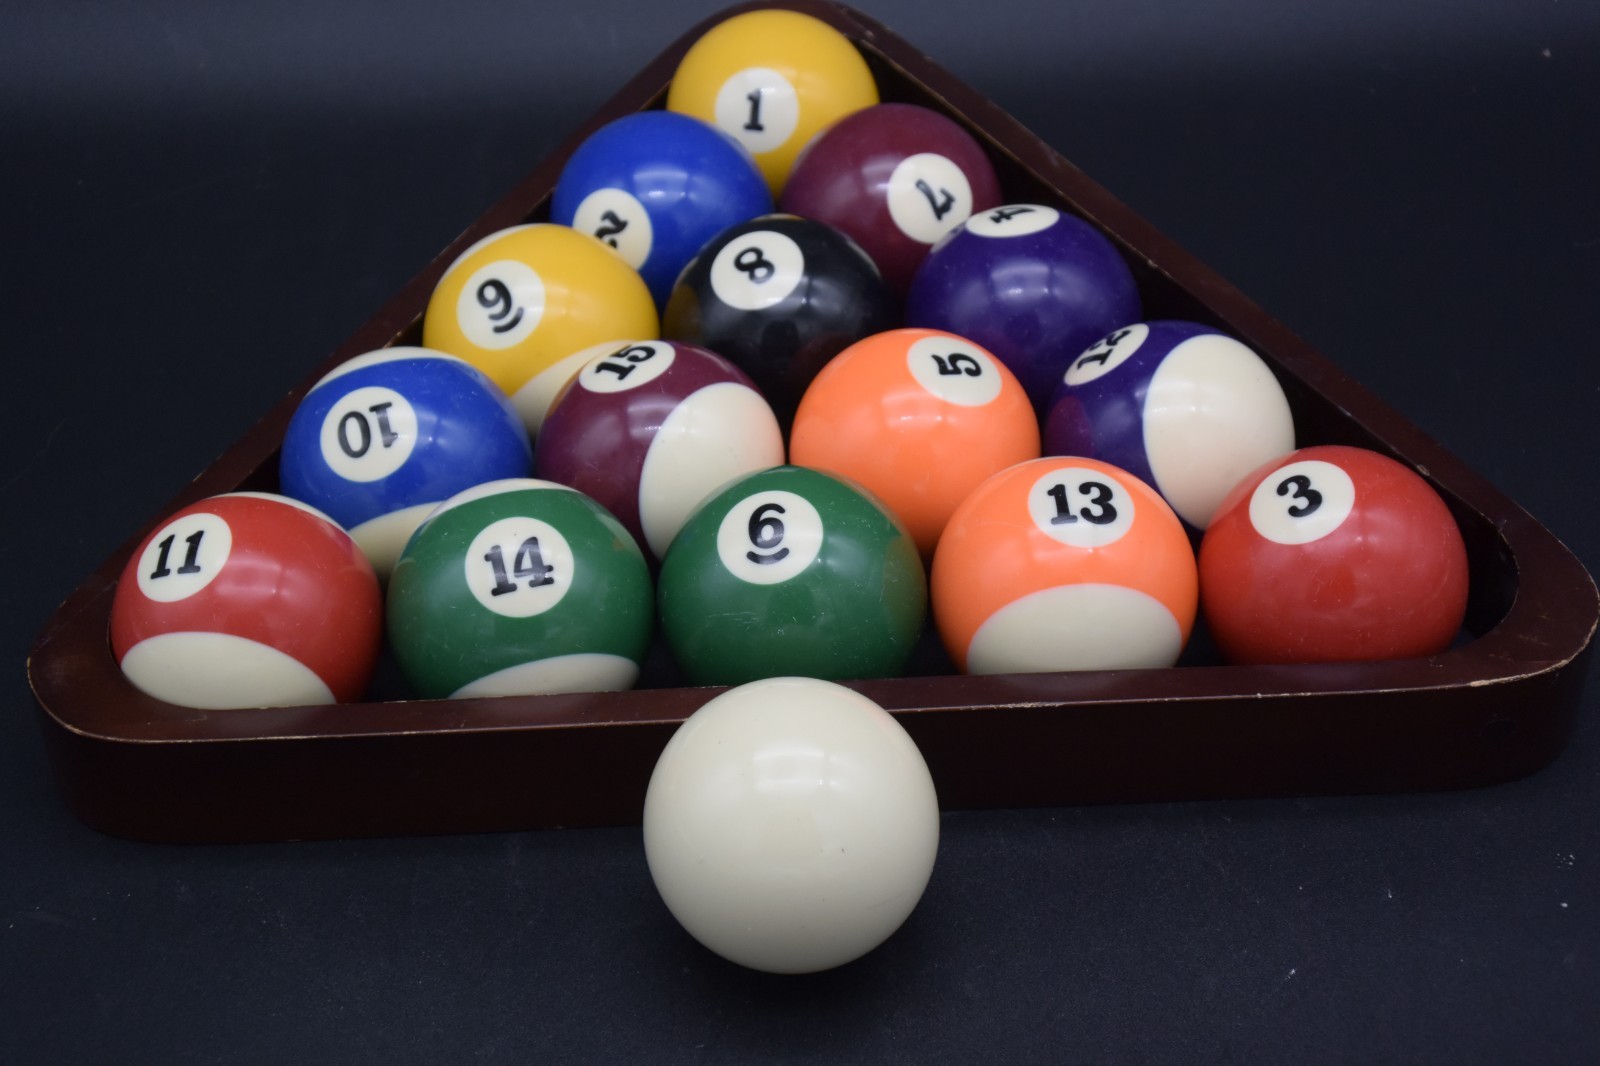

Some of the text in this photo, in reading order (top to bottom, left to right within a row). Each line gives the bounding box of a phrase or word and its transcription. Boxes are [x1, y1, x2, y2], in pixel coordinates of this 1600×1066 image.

[744, 89, 764, 132] 1
[915, 179, 956, 221] 7
[989, 206, 1035, 223] 4
[594, 210, 628, 248] 2
[734, 247, 775, 284] 8
[476, 278, 525, 333] 9
[593, 344, 656, 381] 15
[938, 353, 982, 377] 5
[1076, 329, 1132, 370] 12
[337, 401, 399, 459] 10
[1047, 481, 1117, 525] 13
[1275, 475, 1323, 518] 3
[150, 530, 205, 579] 11
[745, 503, 790, 565] 6
[483, 536, 555, 596] 14
